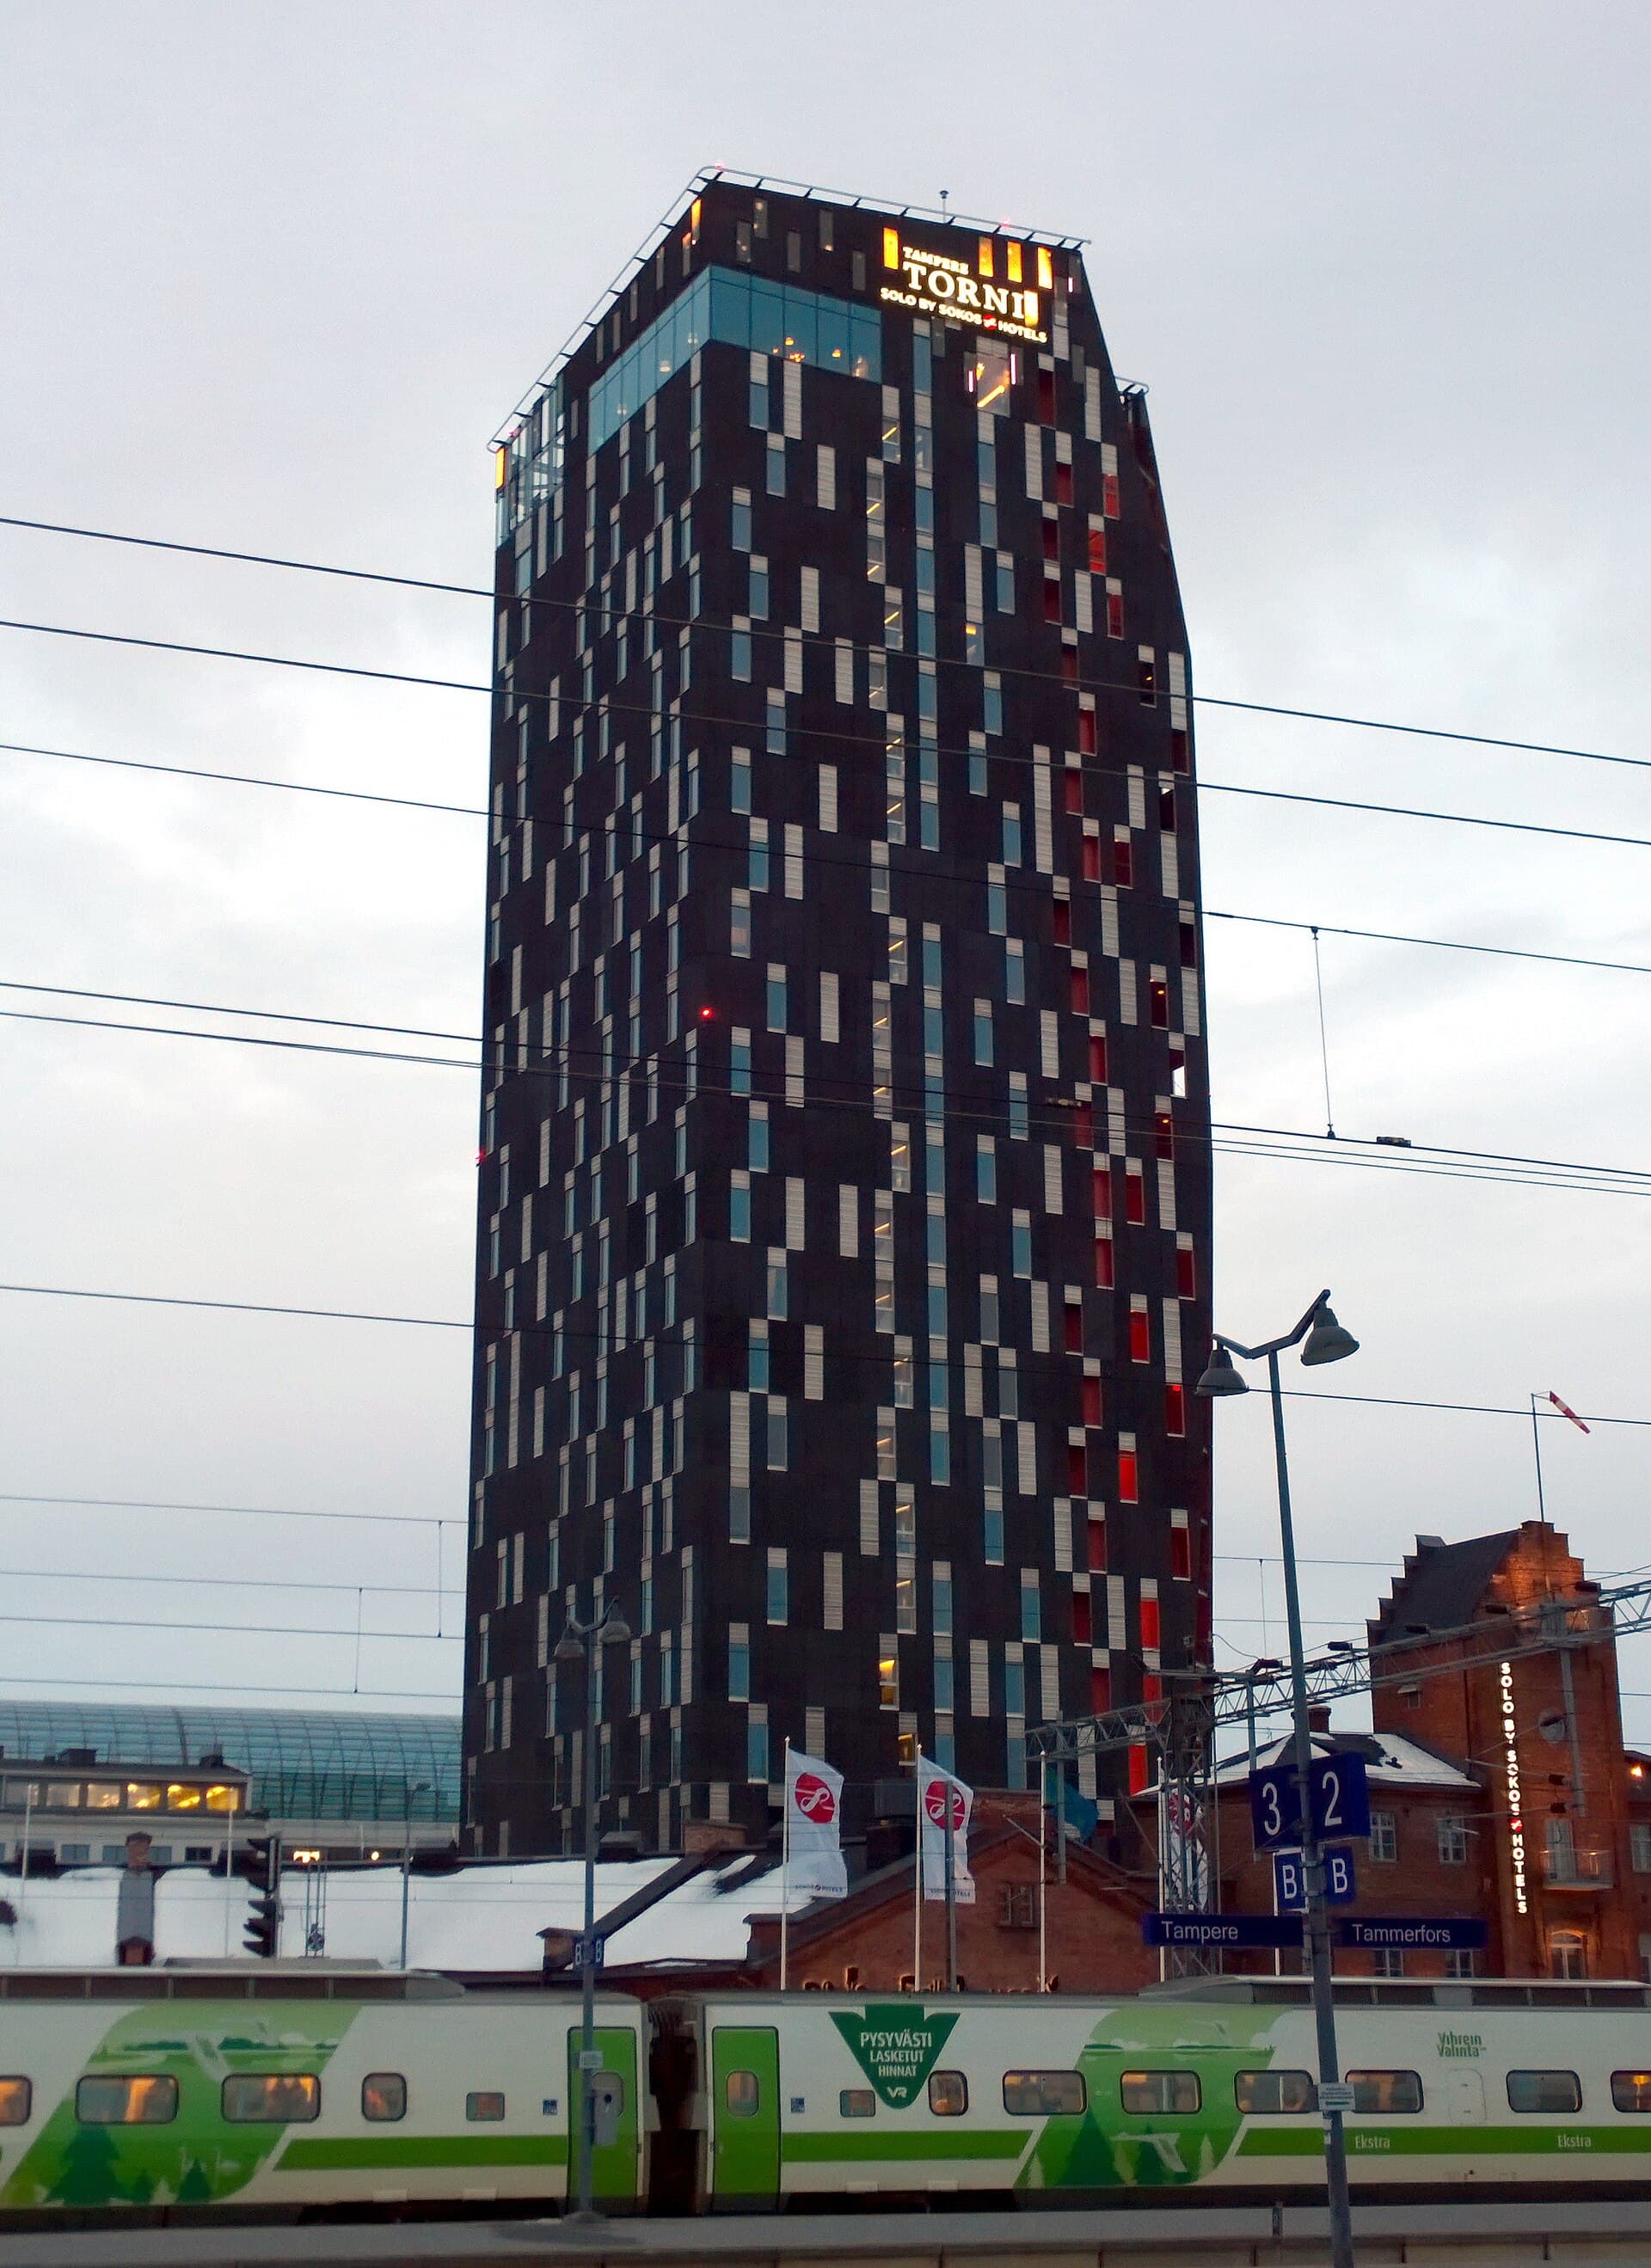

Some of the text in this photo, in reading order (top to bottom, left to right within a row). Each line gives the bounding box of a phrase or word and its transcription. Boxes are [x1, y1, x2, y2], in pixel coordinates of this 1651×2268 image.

[903, 246, 969, 275] TAMPERE
[903, 261, 1024, 320] TORNI
[880, 287, 1047, 344] SOLO BY SOKOS HOTELS
[1322, 1771, 1342, 1828] 2
[1501, 1662, 1527, 1914] SOLO BY SOKOS HOTELS
[1261, 1781, 1281, 1836] 3
[1282, 1864, 1298, 1900] B
[1332, 1857, 1348, 1894] B
[1161, 1920, 1238, 1944] Tampere
[1352, 1923, 1451, 1943] Tammerfors
[575, 1944, 582, 1965] B
[596, 1939, 603, 1963] B
[860, 2028, 932, 2048] PYSYVÄSTI
[1437, 2030, 1482, 2045] Vihrein
[869, 2050, 924, 2063] LASKETUT
[878, 2064, 918, 2077] HINNAT
[886, 2087, 908, 2099] VR
[1354, 2134, 1390, 2149] Ekstra
[1557, 2133, 1592, 2148] Ekstra
